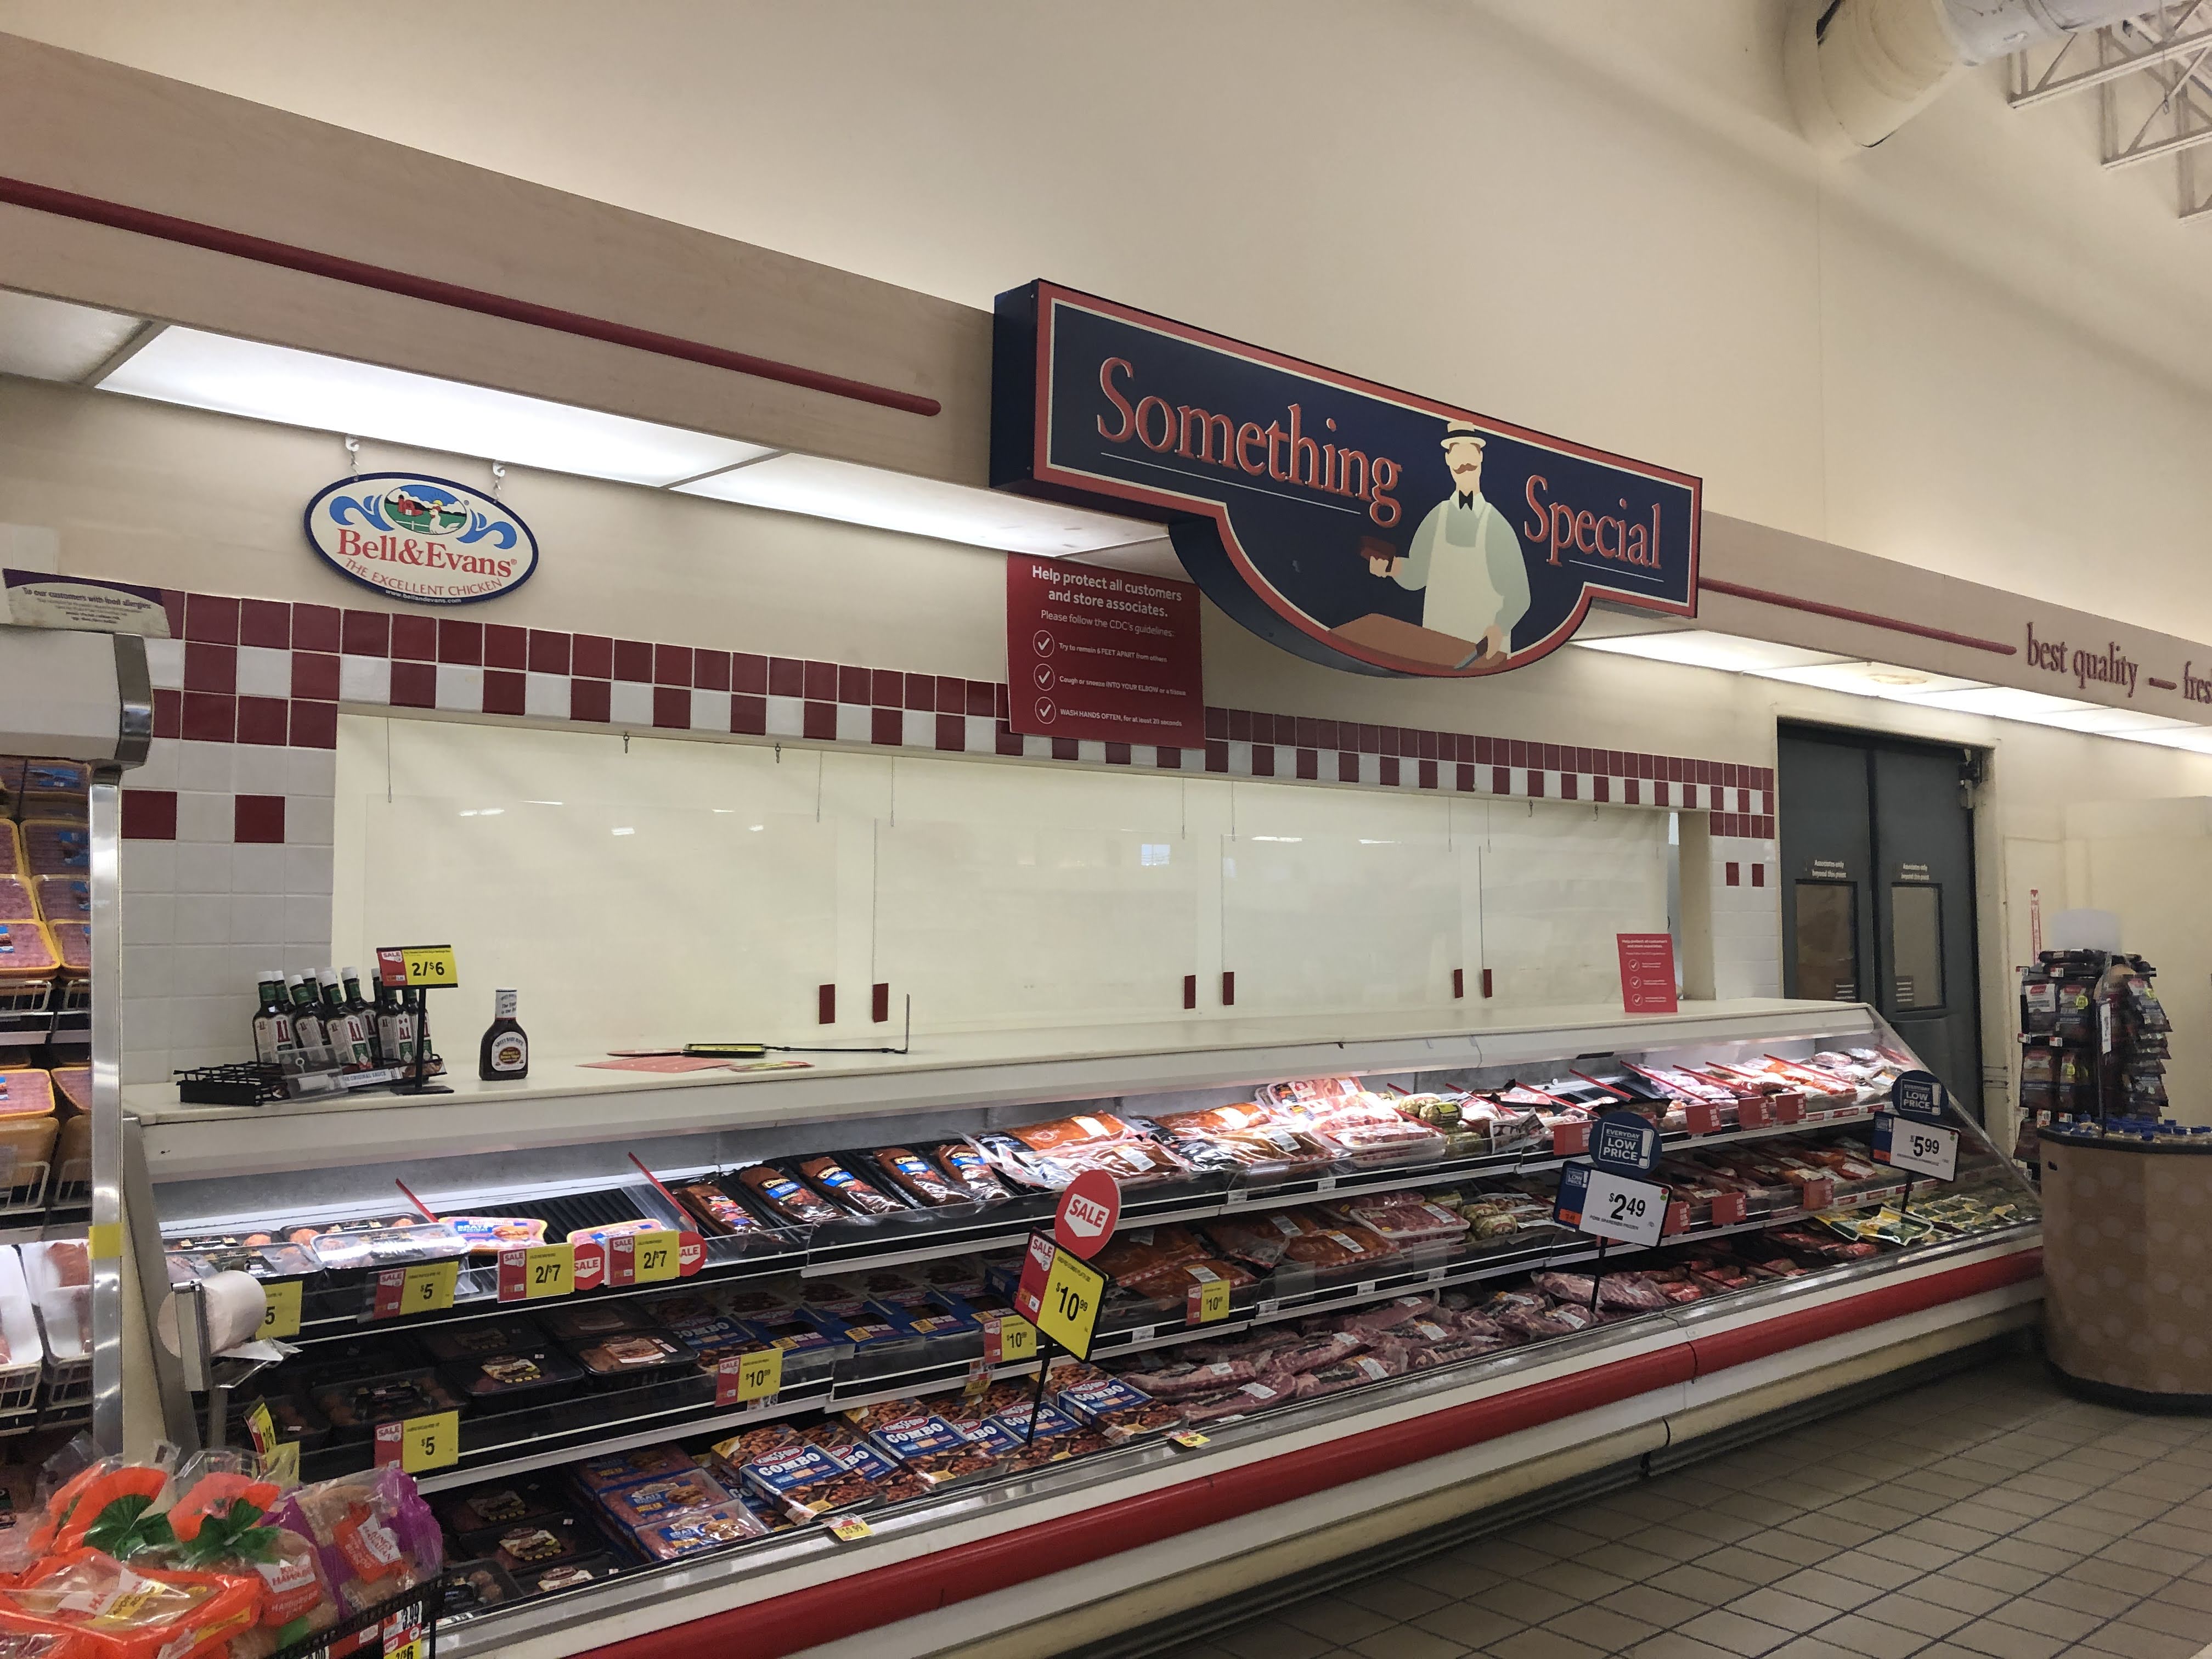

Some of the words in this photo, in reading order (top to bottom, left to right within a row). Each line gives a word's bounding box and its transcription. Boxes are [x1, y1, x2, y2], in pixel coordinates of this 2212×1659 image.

[1097, 357, 1403, 528] Something
[1525, 475, 1662, 569] Special
[344, 558, 368, 578] THE
[371, 572, 445, 596] EXCELLENT
[448, 578, 503, 597] CHICKEN
[1032, 565, 1061, 585] Help
[1063, 573, 1108, 590] protect
[1109, 579, 1122, 592] all
[1124, 583, 1182, 602] customers
[48, 591, 86, 601] customers
[1048, 589, 1070, 603] and
[1073, 593, 1104, 607] store
[1105, 598, 1169, 617] associates.
[1041, 610, 1068, 623] Please
[1069, 614, 1093, 627] follow
[1094, 618, 1108, 628] the
[1109, 619, 1134, 631] CDC's
[1059, 642, 1068, 651] Try
[1101, 648, 1116, 656] FEET
[1116, 650, 1135, 658] APART
[1136, 652, 1149, 660] from
[2027, 622, 2068, 674] best
[2073, 641, 2138, 698] quality
[2183, 661, 2212, 704] fres
[1059, 675, 1078, 685] Cough
[1121, 683, 1137, 691] YOUR
[1138, 684, 1158, 693] ELBOW
[1060, 708, 1079, 716] WASH
[1079, 710, 1100, 719] HANDS
[1101, 713, 1122, 722] OFTEN,
[412, 961, 445, 976] 2/$6
[1904, 1099, 1931, 1109] PRICE
[1906, 1091, 1928, 1101] LOW
[1606, 1128, 1640, 1140] EVERYDAY
[1607, 1138, 1637, 1150] LOW
[1603, 1147, 1638, 1161] PRICE
[1069, 1199, 1105, 1228] SALE
[505, 1252, 523, 1261] SALE
[679, 1246, 699, 1257] ALE
[1032, 1239, 1052, 1258] SALE
[574, 1259, 599, 1271] SALE
[381, 1272, 402, 1282] SALE
[420, 1283, 433, 1300] $5
[721, 1361, 738, 1370] SALE
[1074, 1385, 1124, 1401] COMBO
[379, 1425, 399, 1436] SALE
[886, 1423, 944, 1443] COMBO
[421, 1436, 435, 1455] $5
[758, 1452, 821, 1476] COMBO
